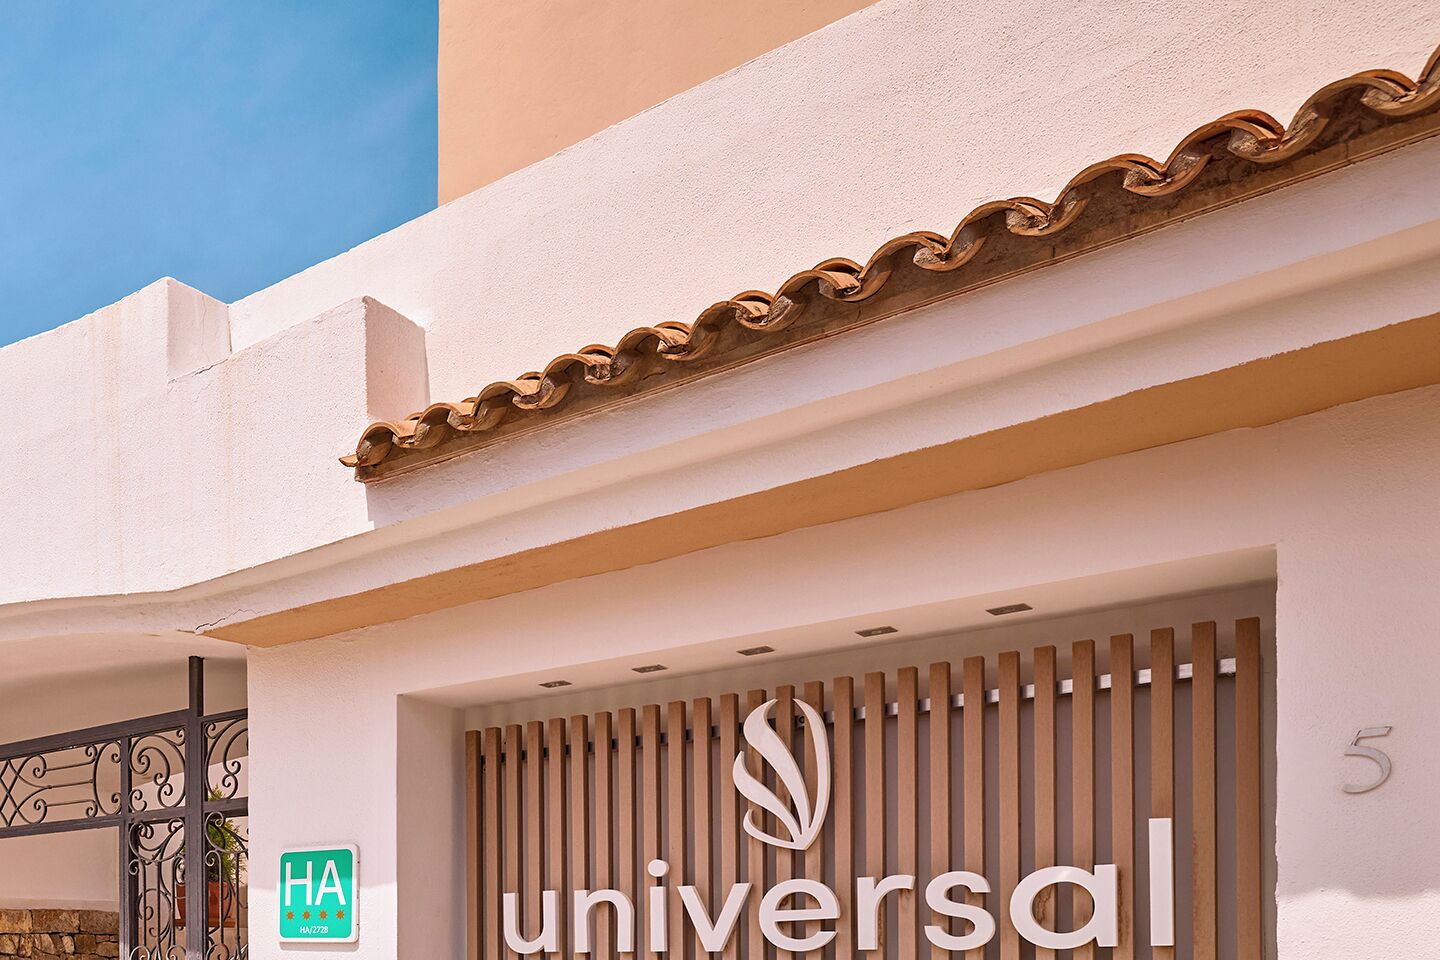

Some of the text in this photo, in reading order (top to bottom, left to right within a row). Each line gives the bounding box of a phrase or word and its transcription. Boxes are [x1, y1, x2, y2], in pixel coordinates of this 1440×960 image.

[1342, 725, 1392, 794] 5
[285, 860, 346, 906] HA
[502, 817, 1176, 954] universal
